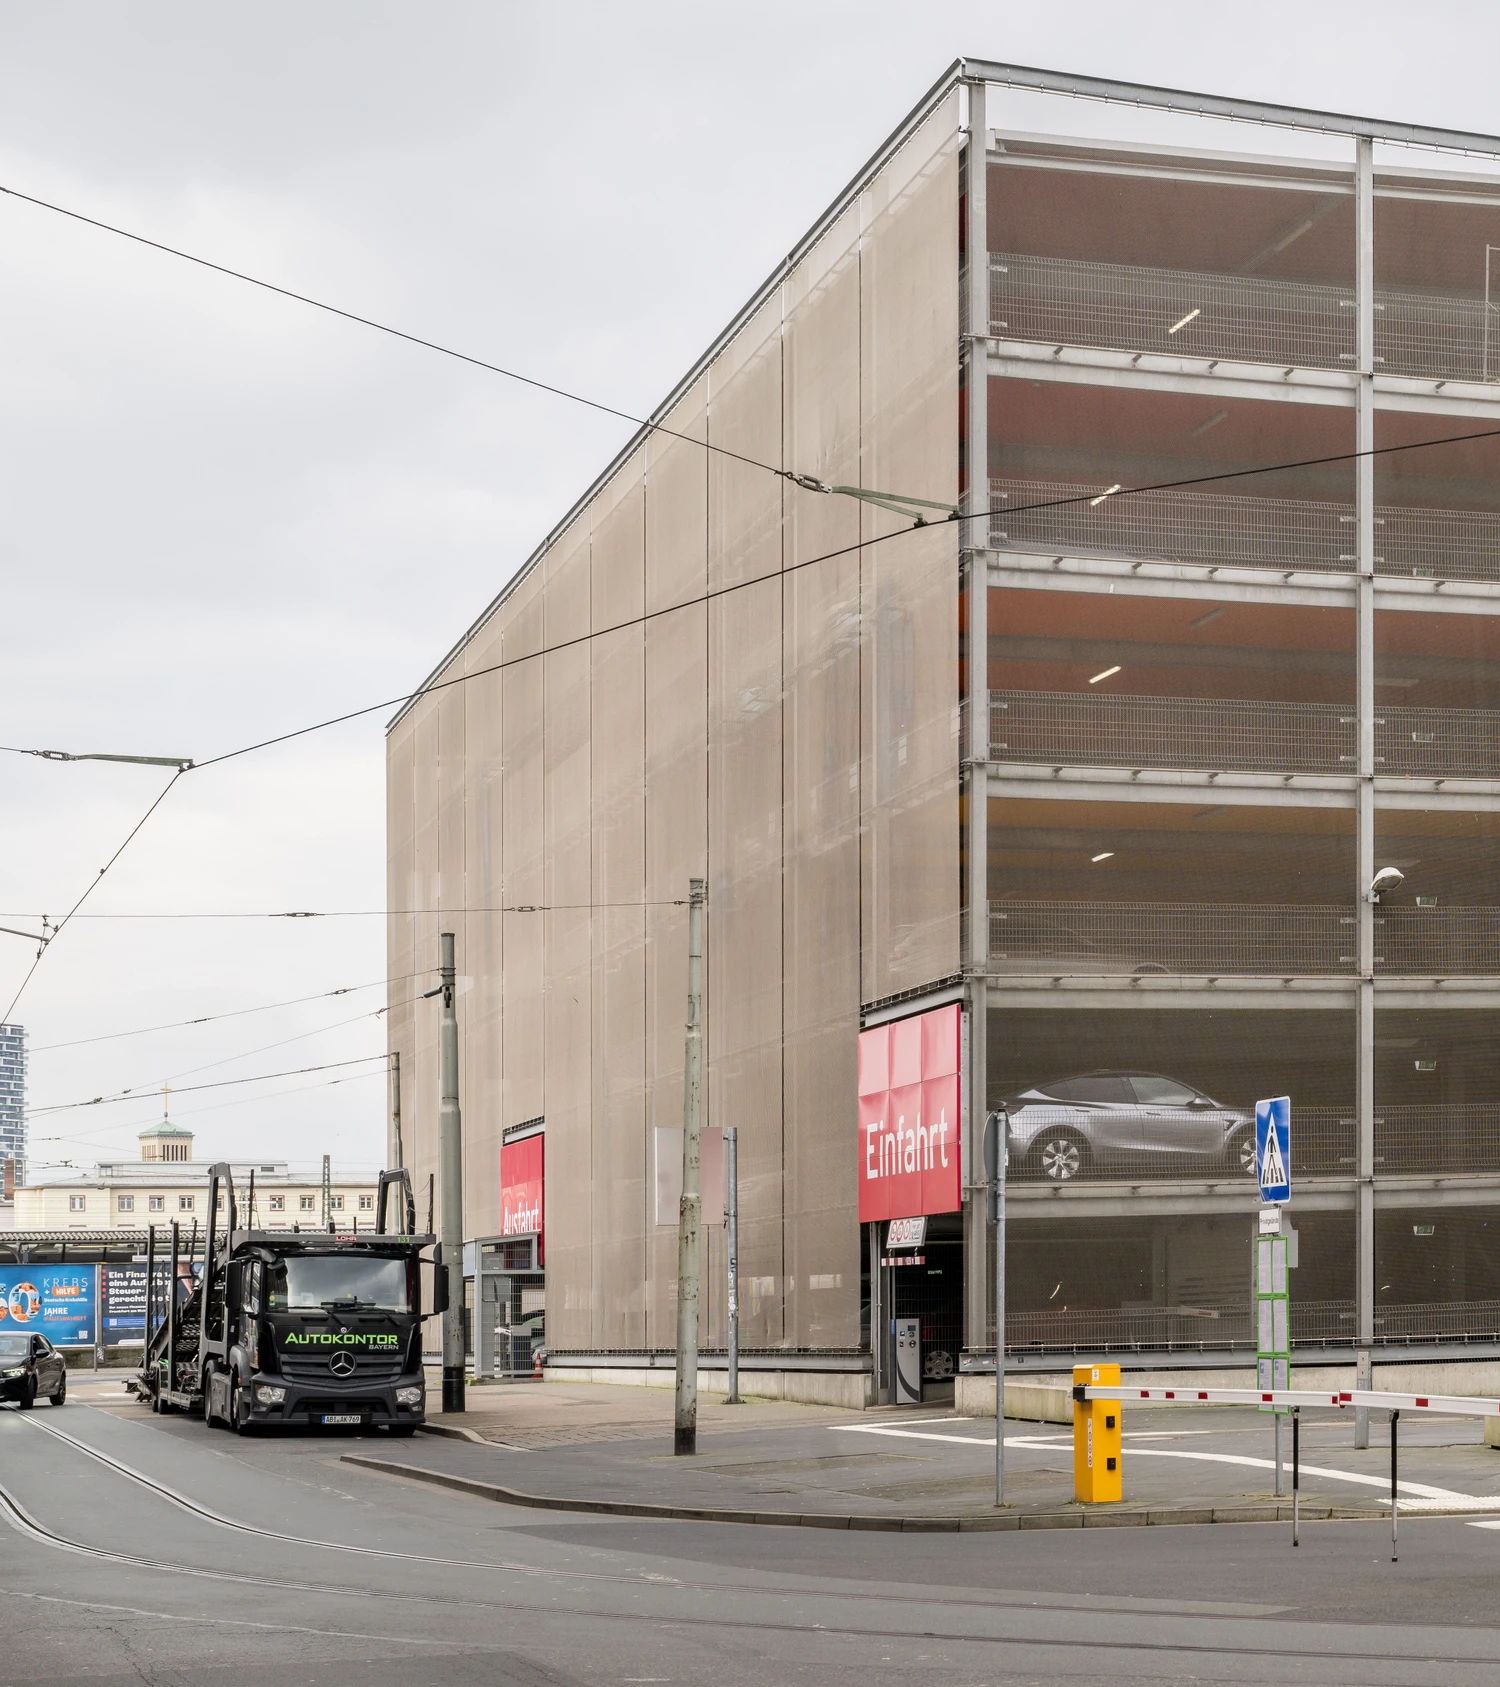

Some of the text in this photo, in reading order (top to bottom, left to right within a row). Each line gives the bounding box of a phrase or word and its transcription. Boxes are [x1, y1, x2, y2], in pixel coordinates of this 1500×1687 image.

[866, 1106, 948, 1179] Einfahrt
[504, 1199, 539, 1235] Ausfahrt
[44, 1277, 88, 1287] KREBS
[109, 1279, 128, 1287] eine
[44, 1307, 68, 1316] JAHRE
[285, 1332, 398, 1344] AUTOKONTOR
